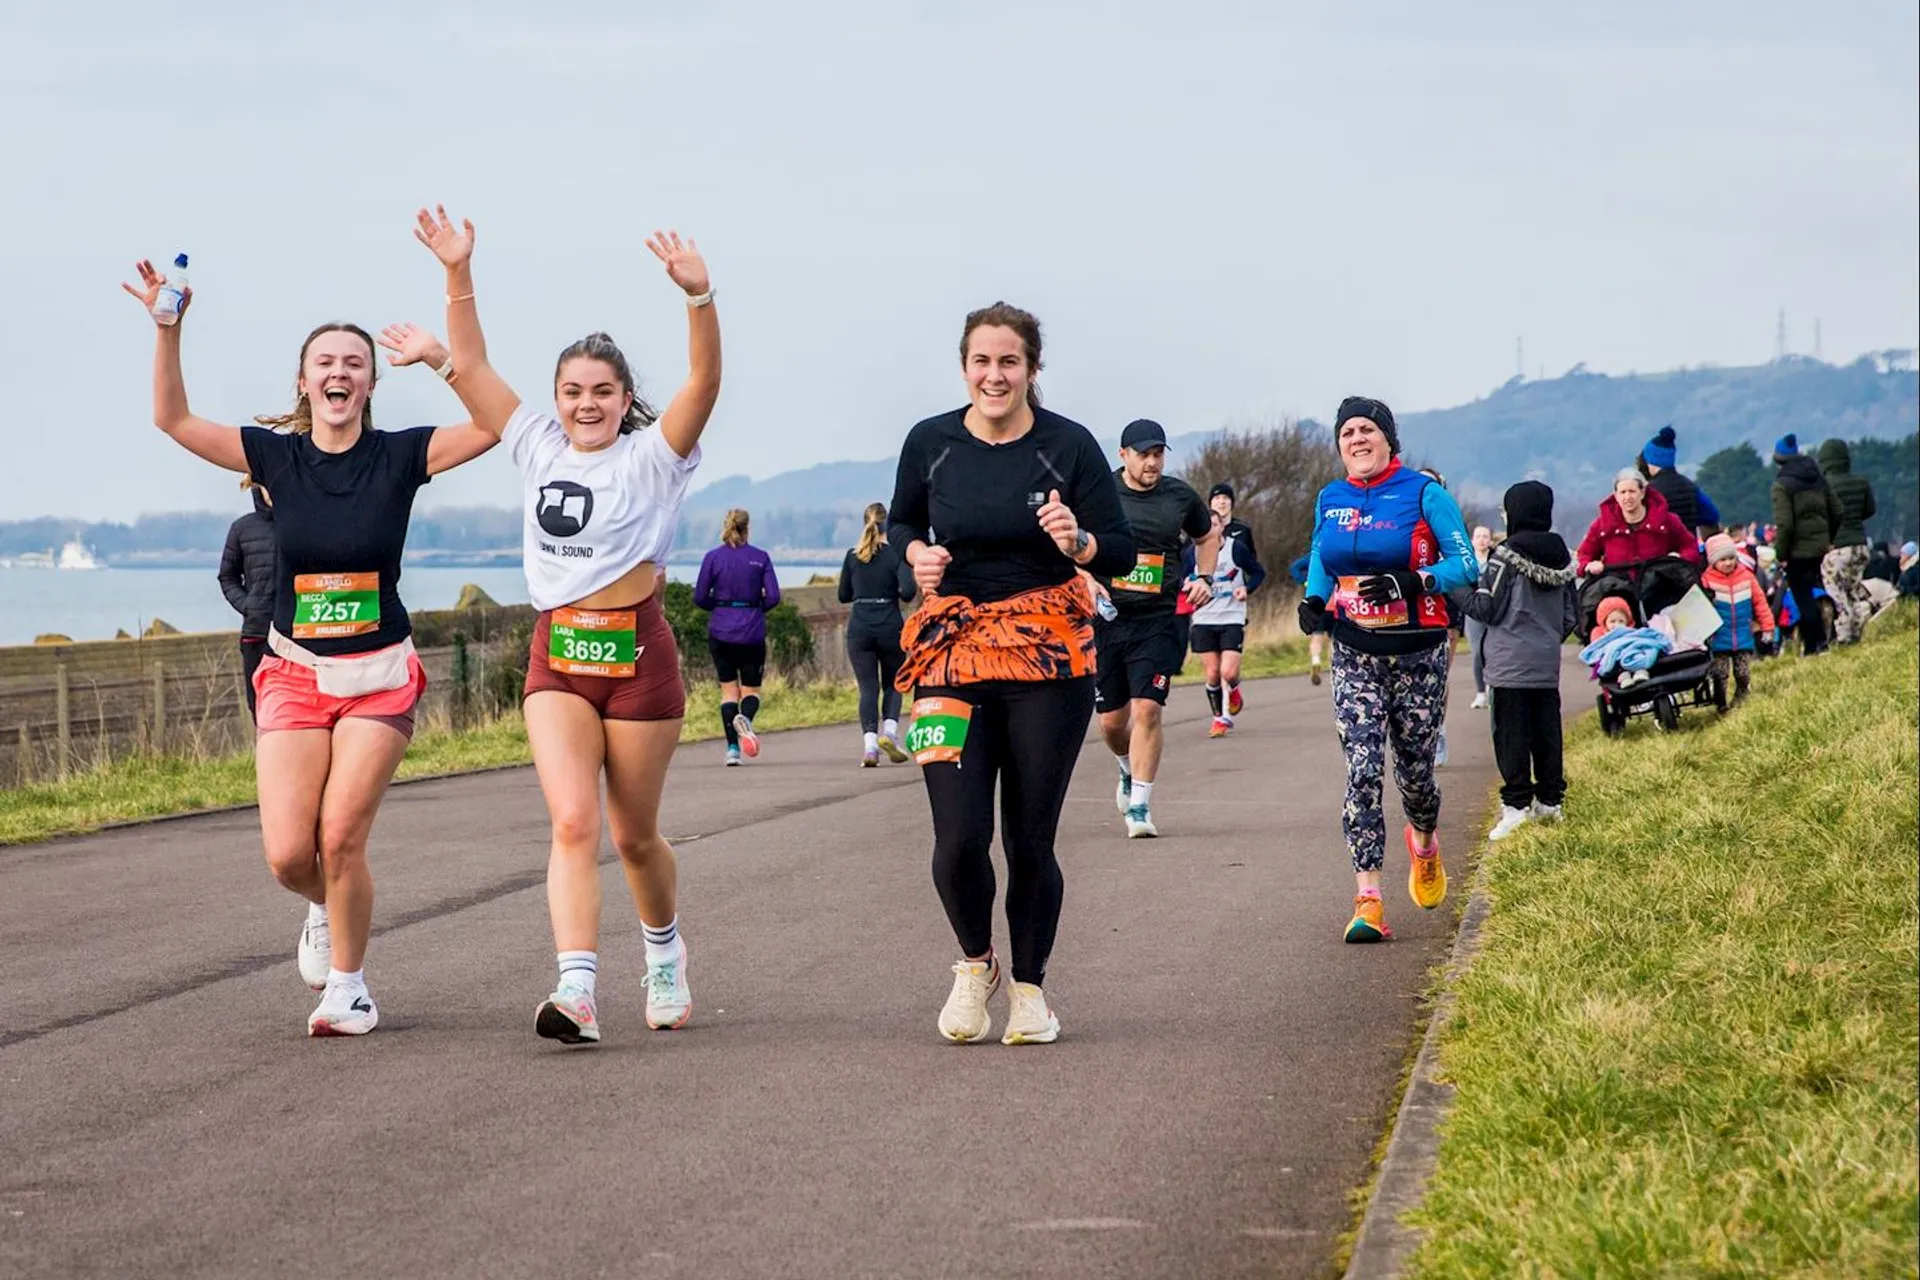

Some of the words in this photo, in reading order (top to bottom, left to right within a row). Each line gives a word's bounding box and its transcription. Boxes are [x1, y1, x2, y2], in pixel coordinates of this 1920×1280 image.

[561, 545, 594, 558] SOUND
[301, 593, 328, 602] BECCA
[309, 601, 361, 622] 3257
[554, 625, 576, 638] LARA
[563, 638, 618, 662] 3692
[910, 725, 947, 753] 3736
